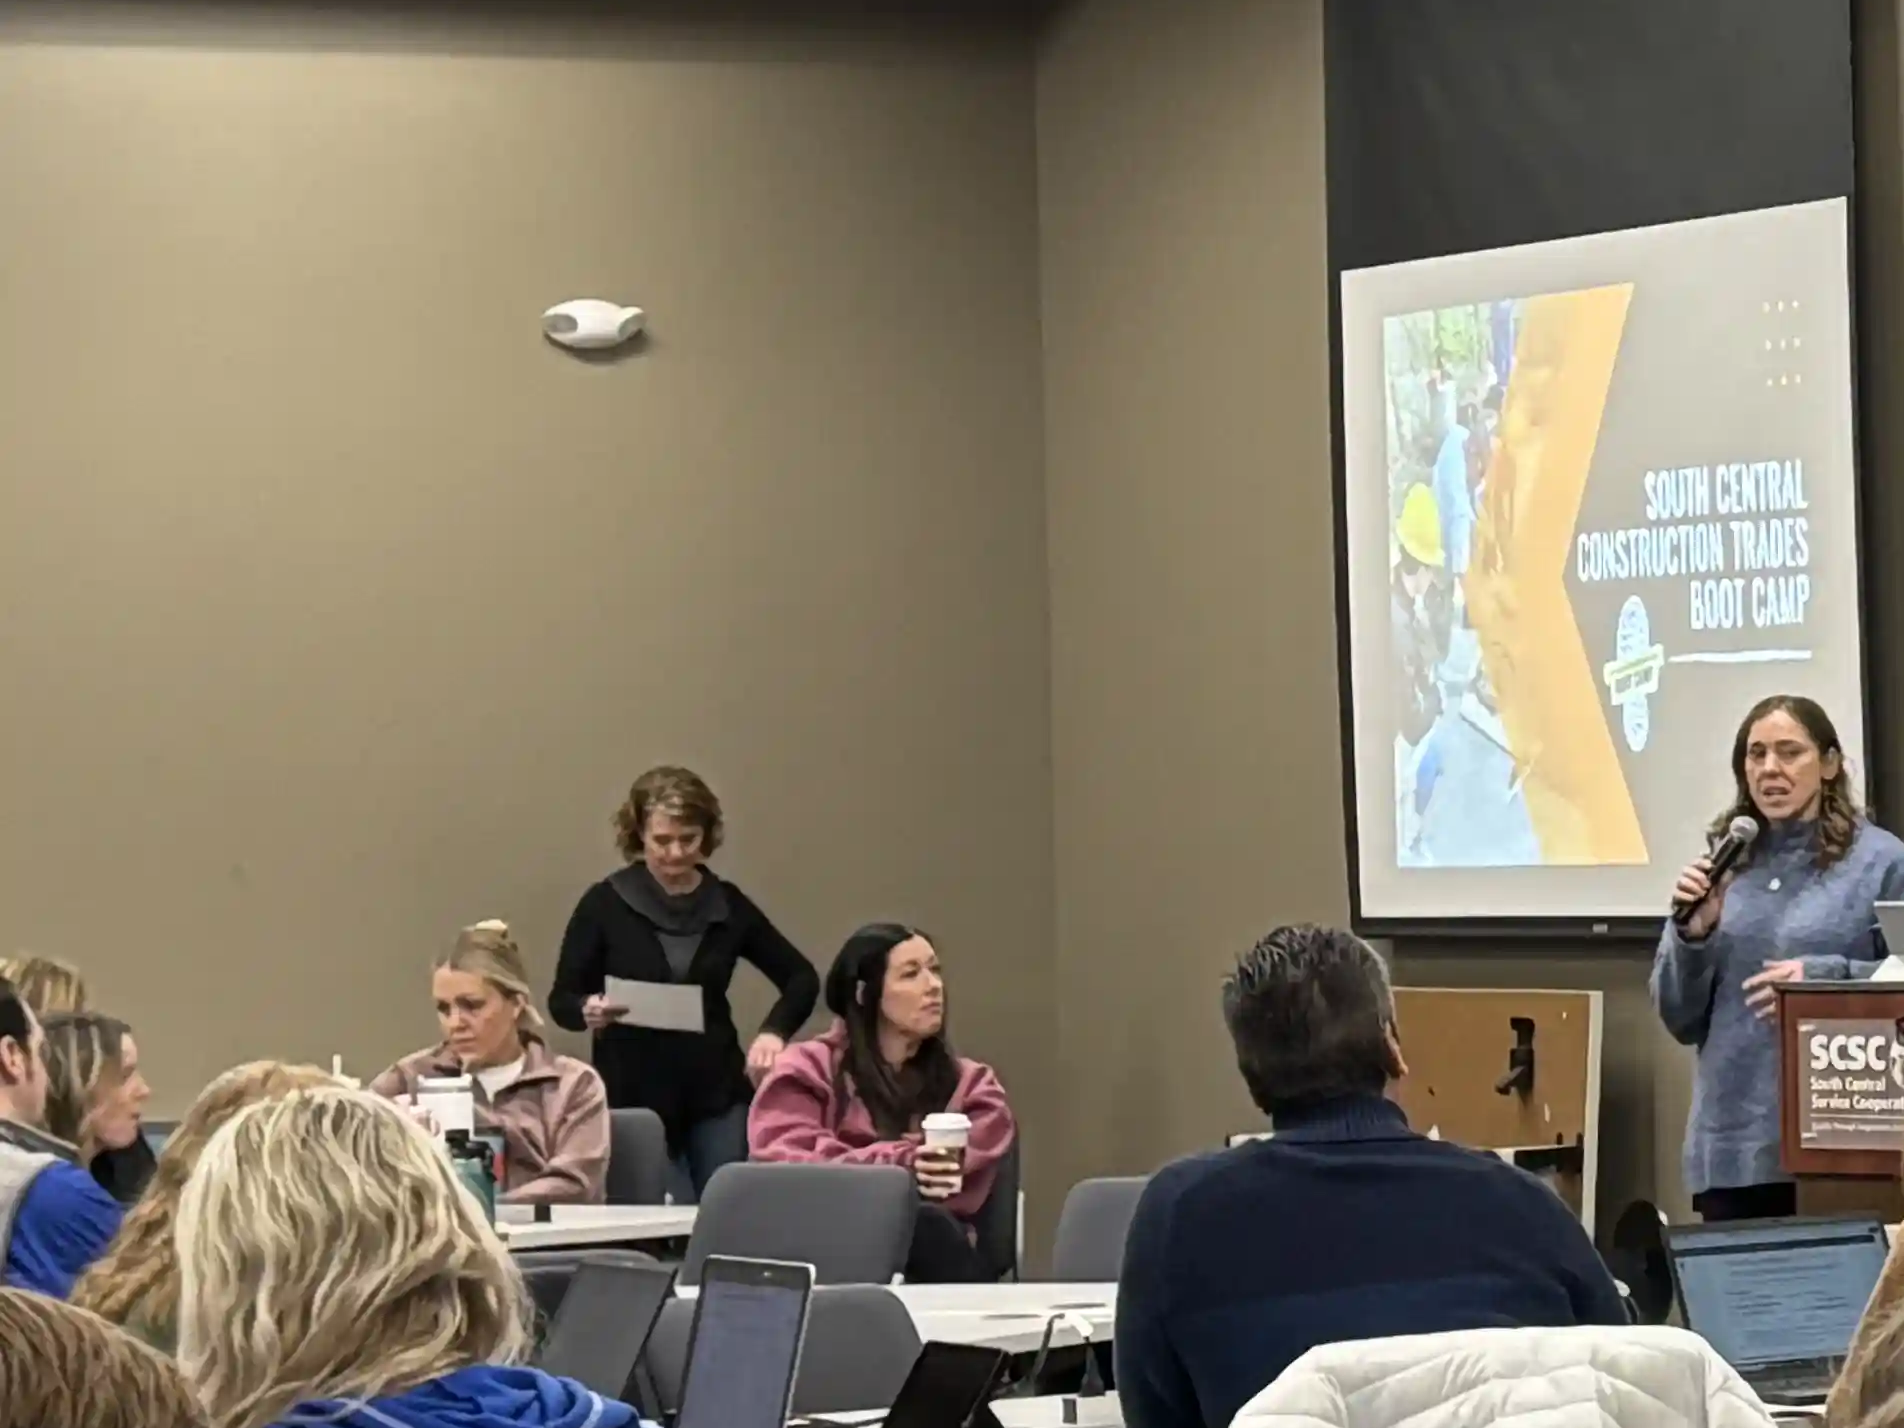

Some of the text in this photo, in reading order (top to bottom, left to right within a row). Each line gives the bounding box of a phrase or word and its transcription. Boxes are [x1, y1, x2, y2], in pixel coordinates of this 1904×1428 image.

[1644, 458, 1809, 520] SOUTH CENTRAL
[1577, 517, 1809, 582] CONSTRUCTION TRADES
[1690, 574, 1810, 630] BOOT CAMP
[1810, 1034, 1886, 1071] SCSC
